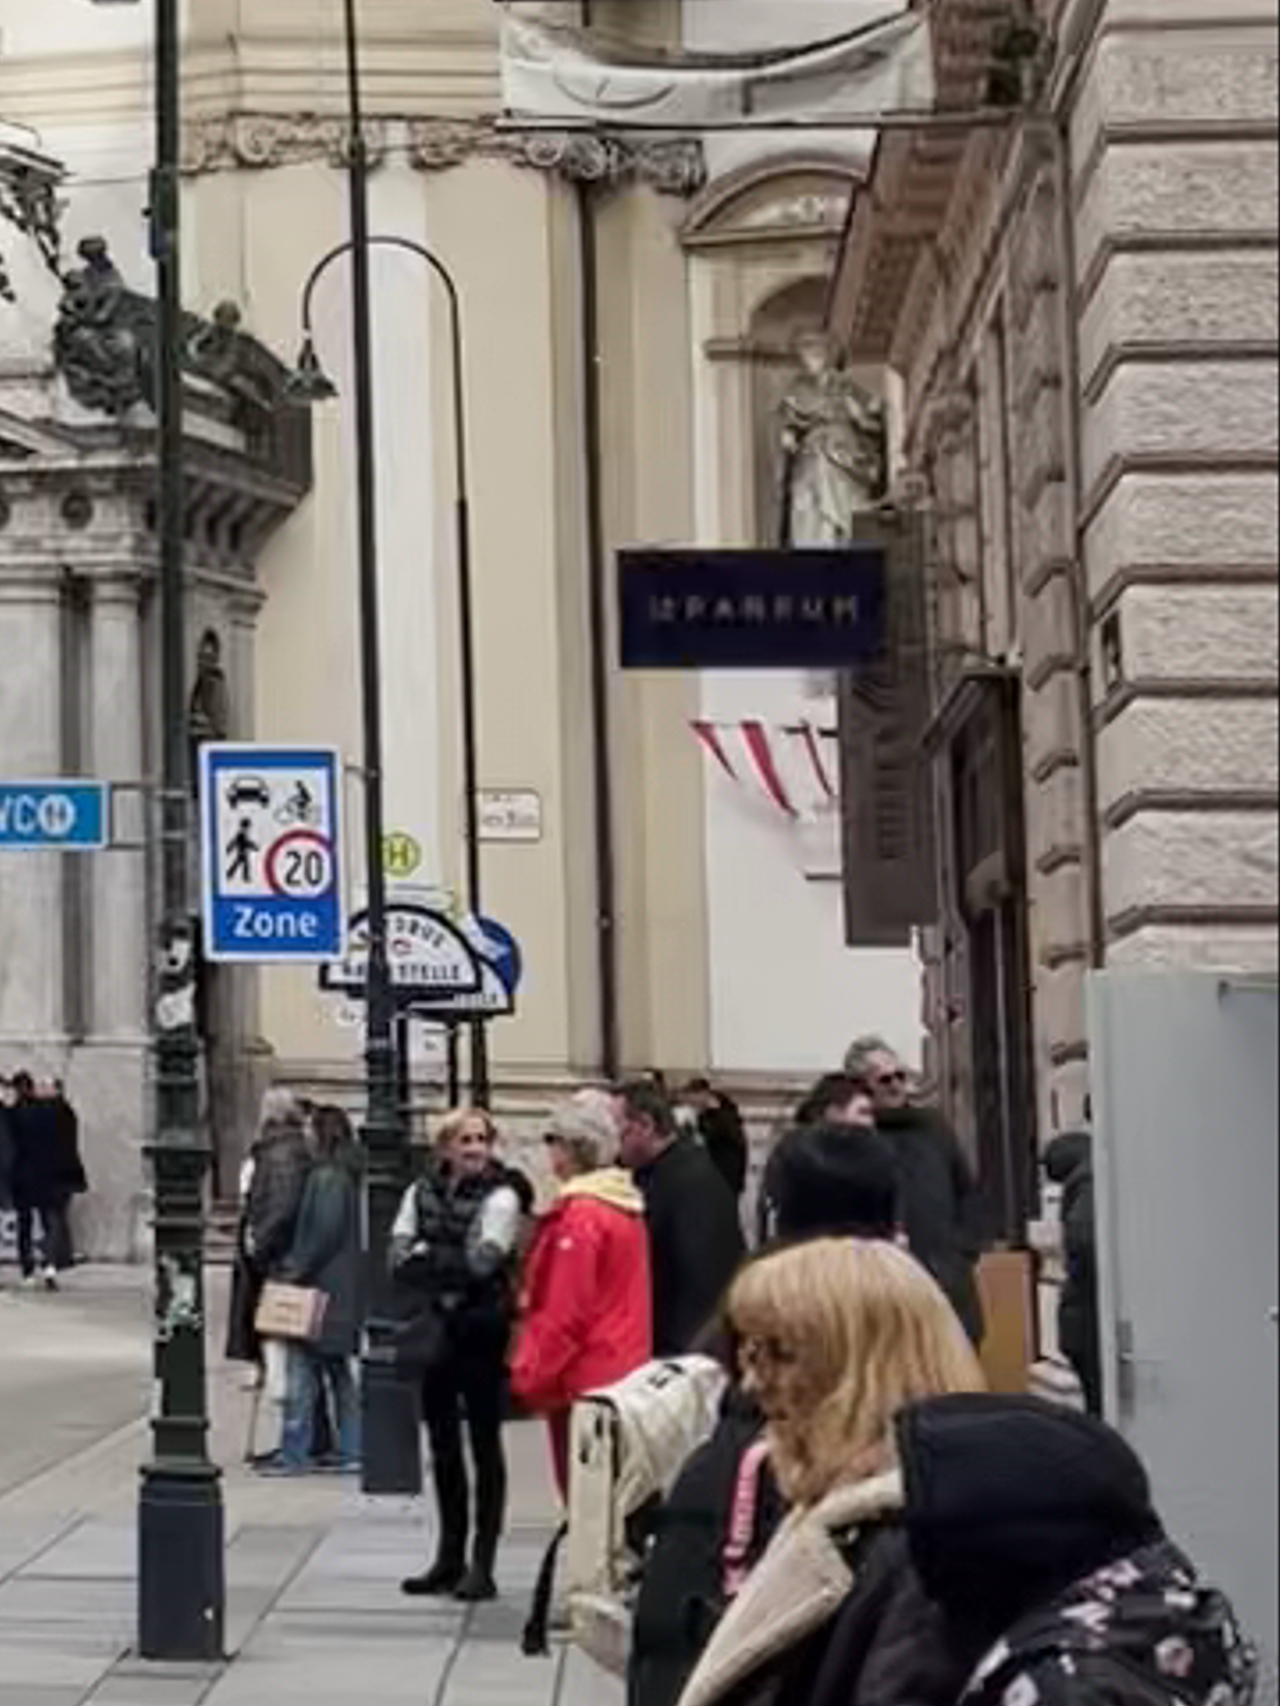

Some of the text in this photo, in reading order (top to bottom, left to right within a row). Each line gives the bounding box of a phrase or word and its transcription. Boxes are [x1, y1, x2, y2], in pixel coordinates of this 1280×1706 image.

[389, 843, 409, 867] H
[284, 854, 325, 888] 20
[234, 904, 319, 939] Zone
[342, 961, 460, 981] HASTELLE
